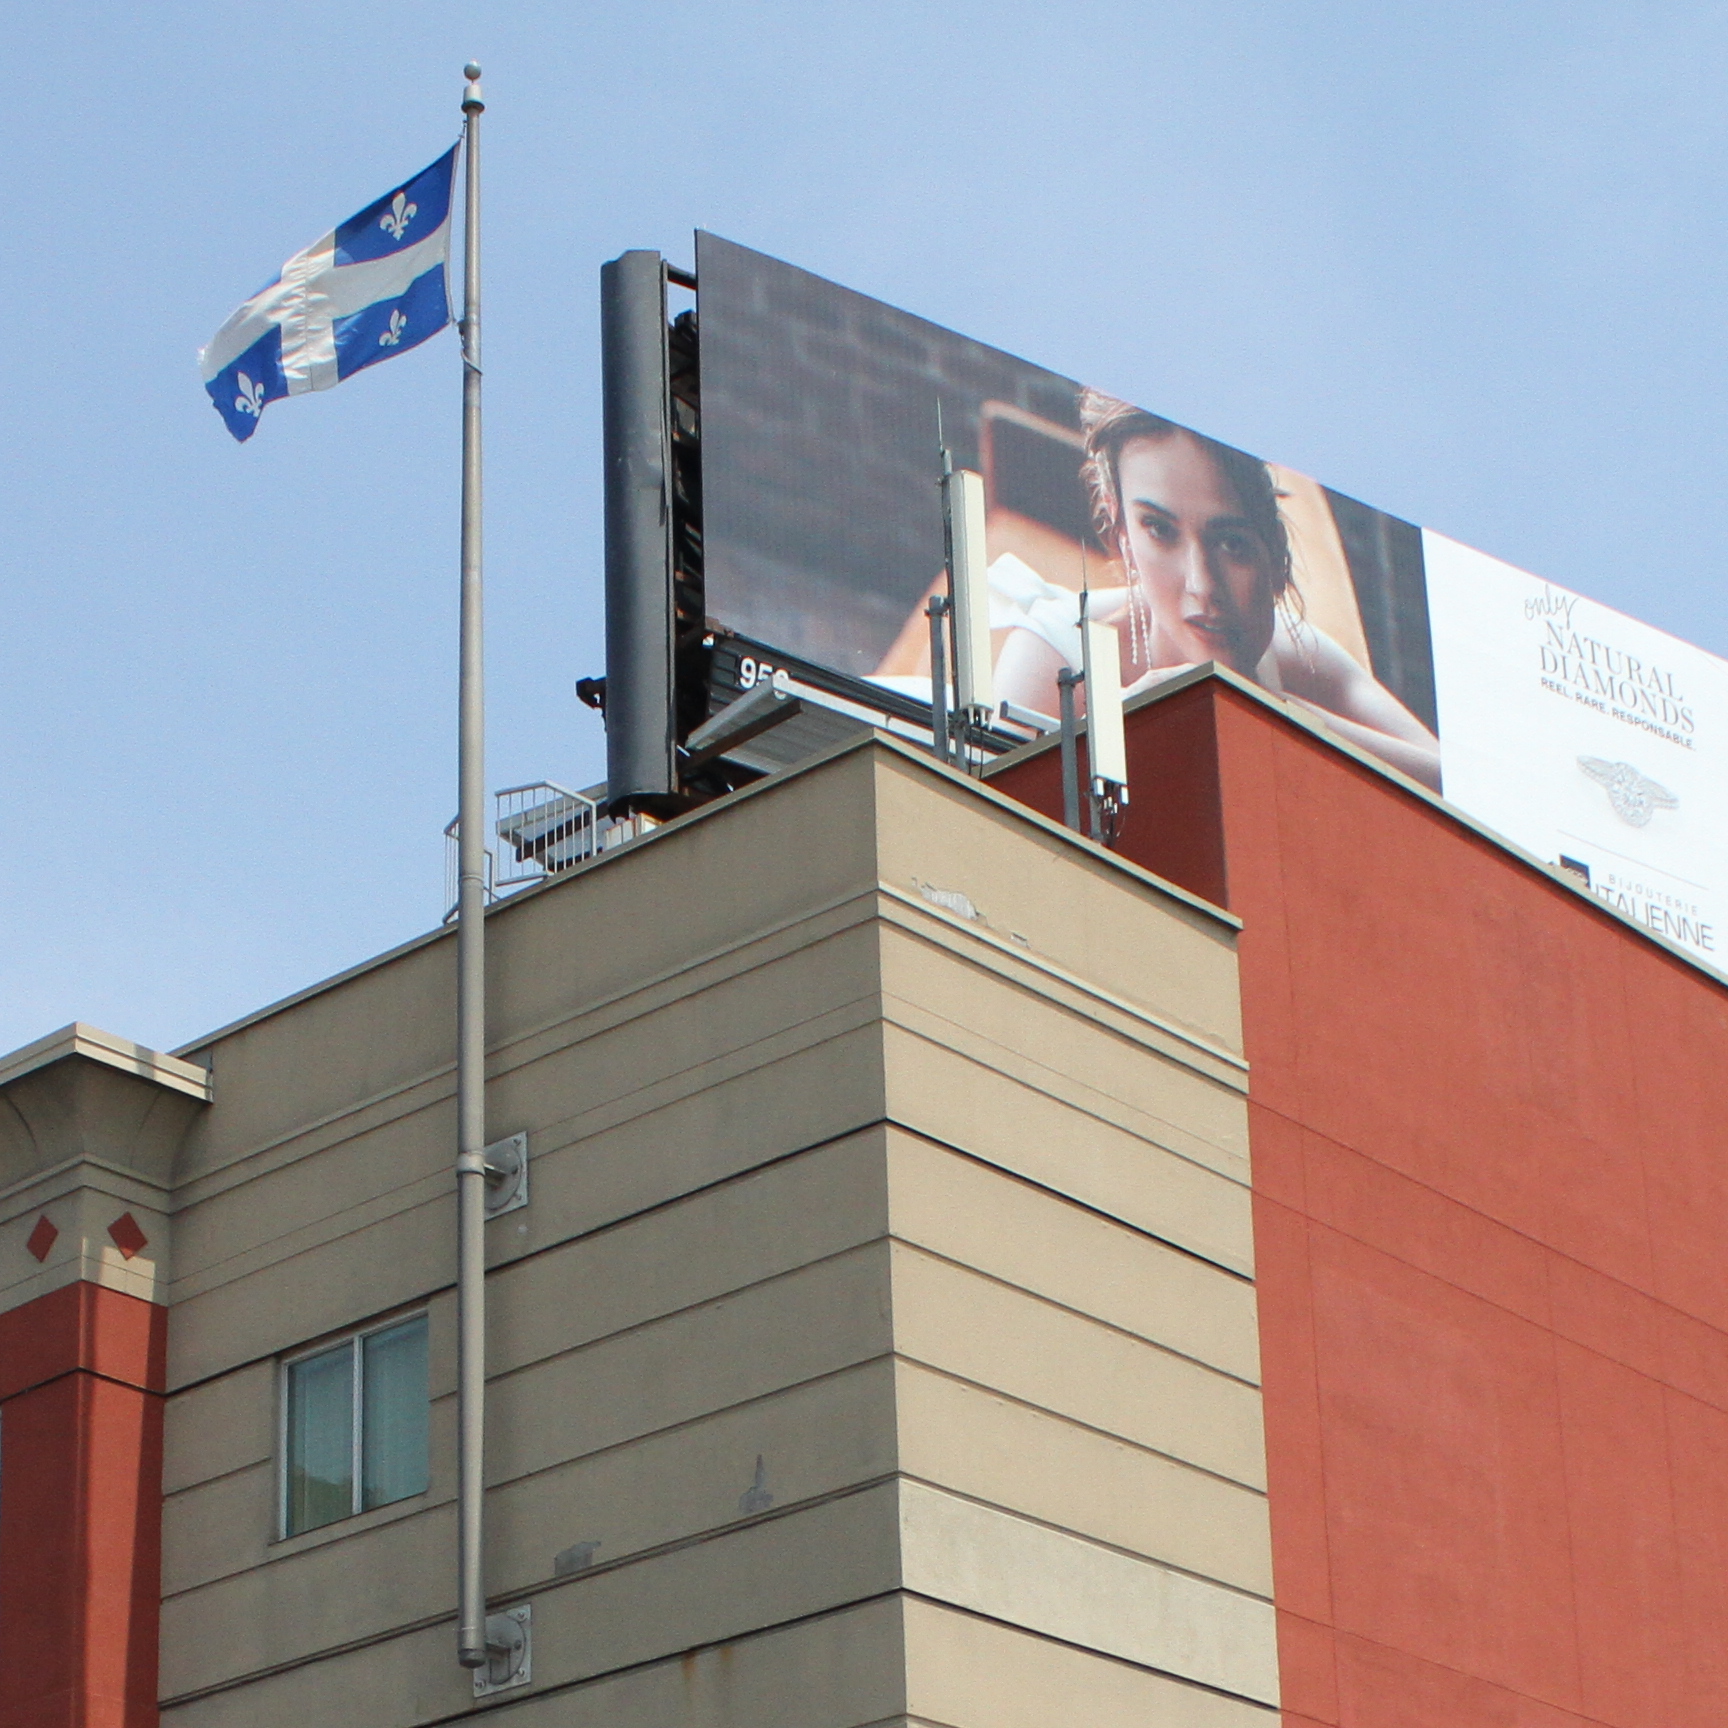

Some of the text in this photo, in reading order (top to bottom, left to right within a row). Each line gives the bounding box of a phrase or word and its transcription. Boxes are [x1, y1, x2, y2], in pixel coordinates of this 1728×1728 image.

[1524, 582, 1579, 631] only
[1539, 645, 1695, 735] DIAMONDS
[1545, 619, 1684, 703] NATURAL
[1575, 691, 1609, 715] RARE.
[1611, 706, 1697, 752] RESPONSABLE.
[1608, 873, 1699, 916] BIJOUTERIE
